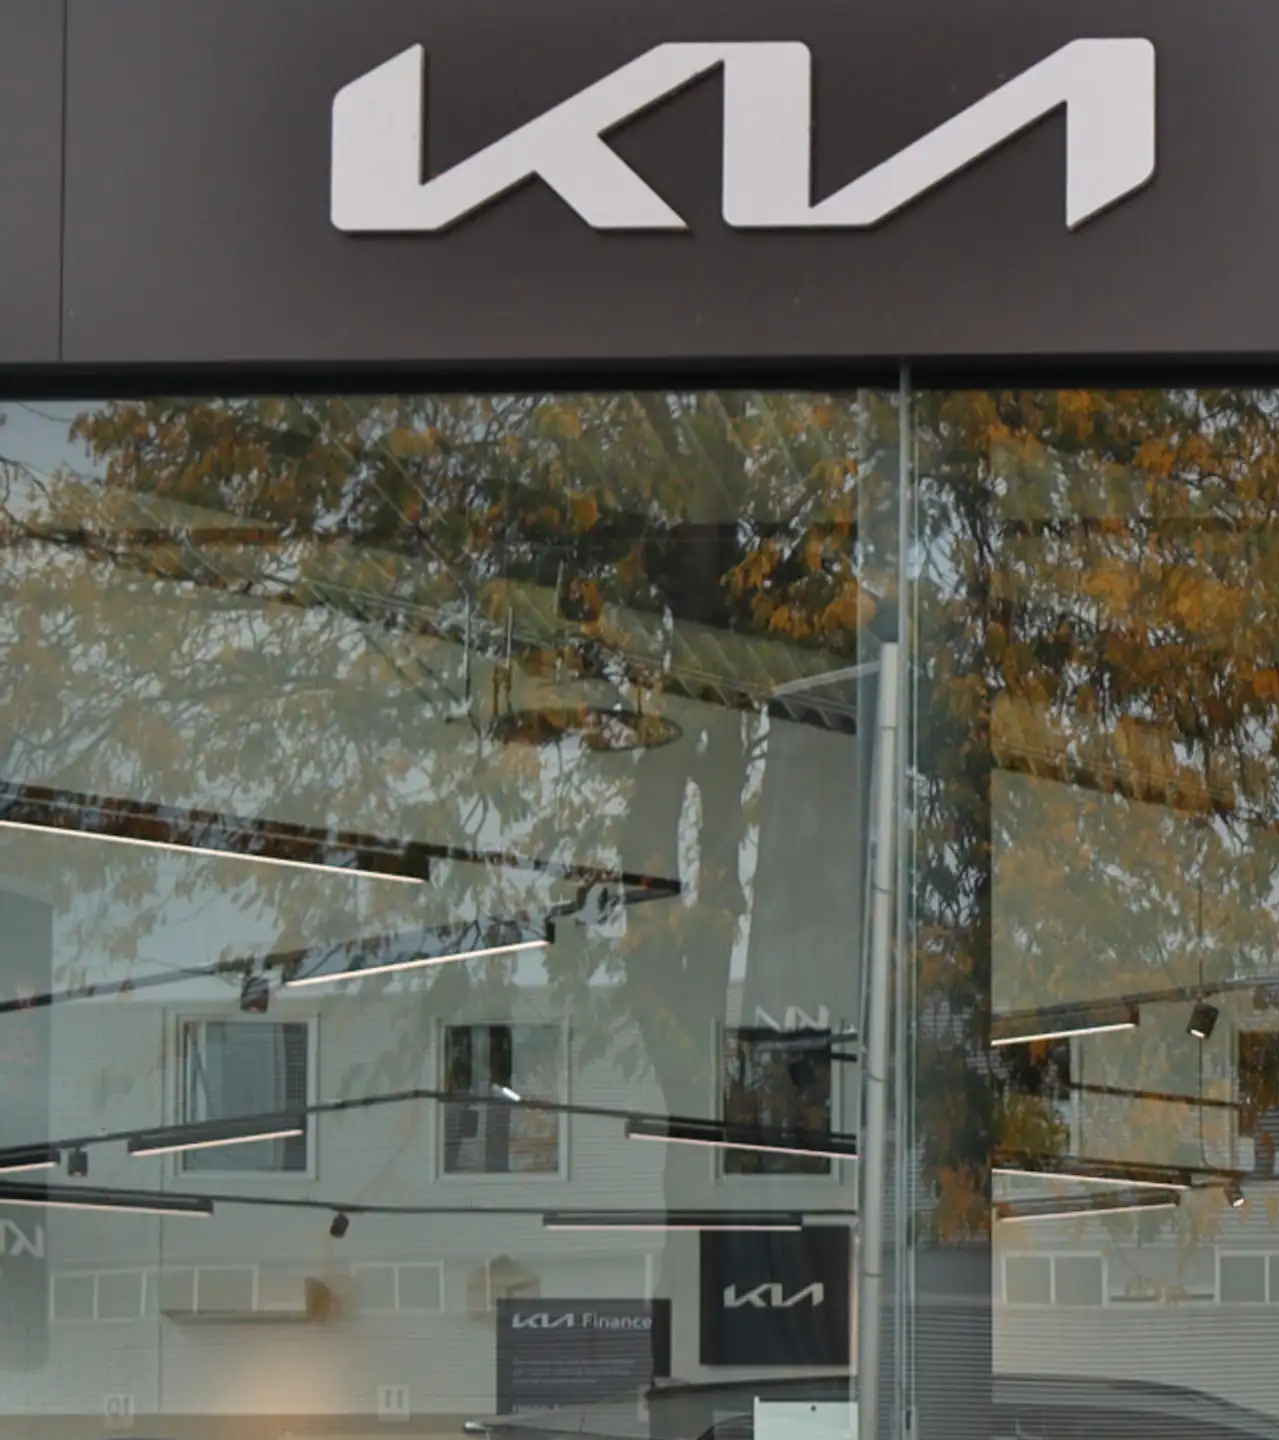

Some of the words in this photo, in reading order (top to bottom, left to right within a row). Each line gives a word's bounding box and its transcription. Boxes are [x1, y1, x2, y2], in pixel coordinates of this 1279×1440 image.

[331, 37, 1156, 232] KIA
[723, 1282, 824, 1308] KIA
[512, 1313, 575, 1329] KIA
[582, 1313, 653, 1329] Finance
